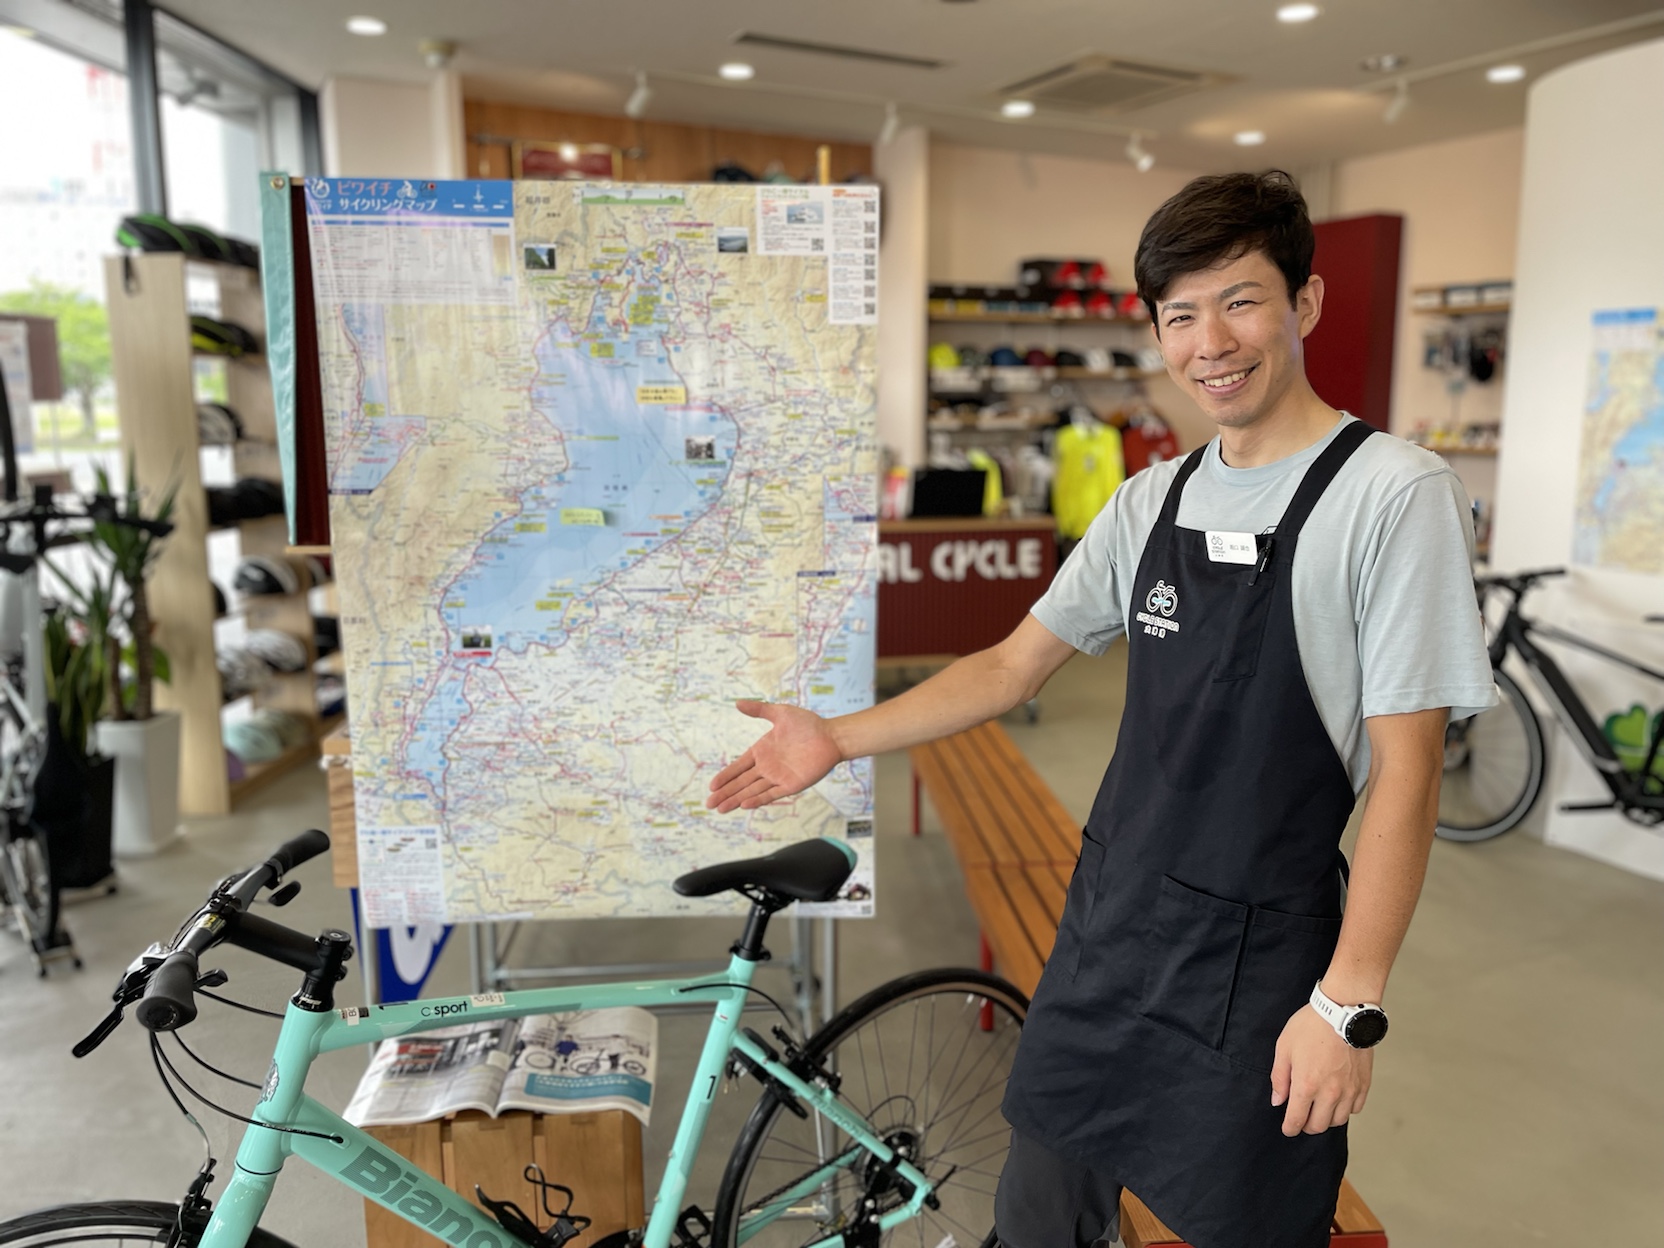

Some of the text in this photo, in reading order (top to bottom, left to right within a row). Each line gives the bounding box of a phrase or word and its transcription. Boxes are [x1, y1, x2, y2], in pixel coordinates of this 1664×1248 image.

[337, 180, 393, 197] ビワイチ
[339, 198, 438, 212] サイクリングマップ
[931, 539, 1042, 582] CYCLE
[434, 1000, 468, 1018] sport
